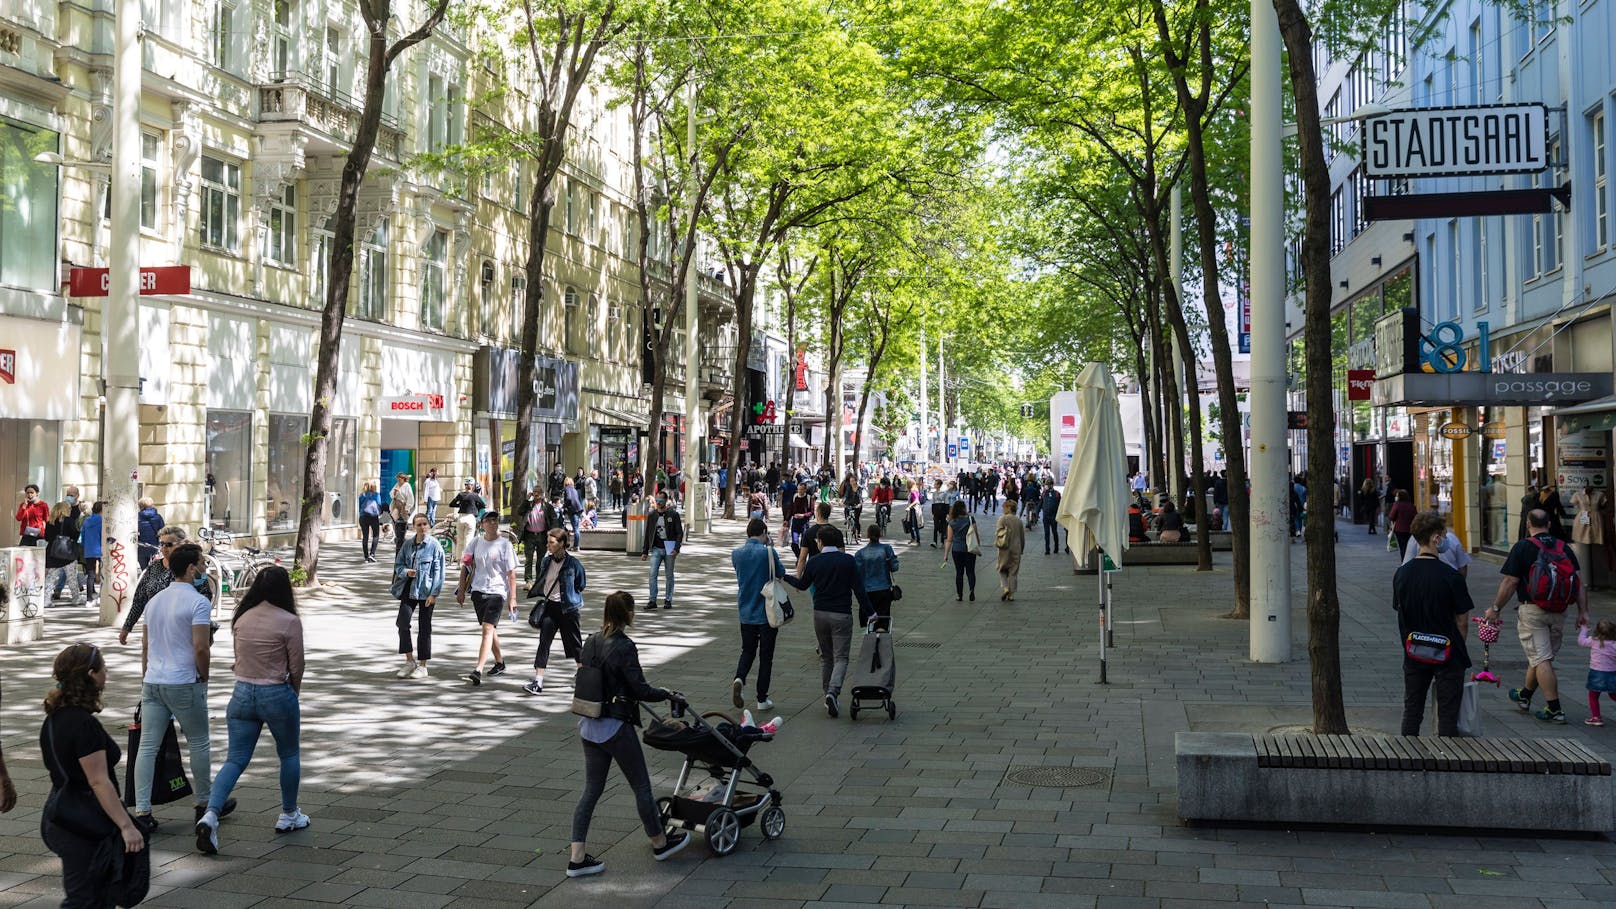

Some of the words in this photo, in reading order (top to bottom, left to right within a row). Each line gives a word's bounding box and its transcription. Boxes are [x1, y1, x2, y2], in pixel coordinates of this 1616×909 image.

[1372, 113, 1539, 168] STADTSAAL
[1495, 381, 1591, 395] passage
[391, 402, 424, 410] BOSCH
